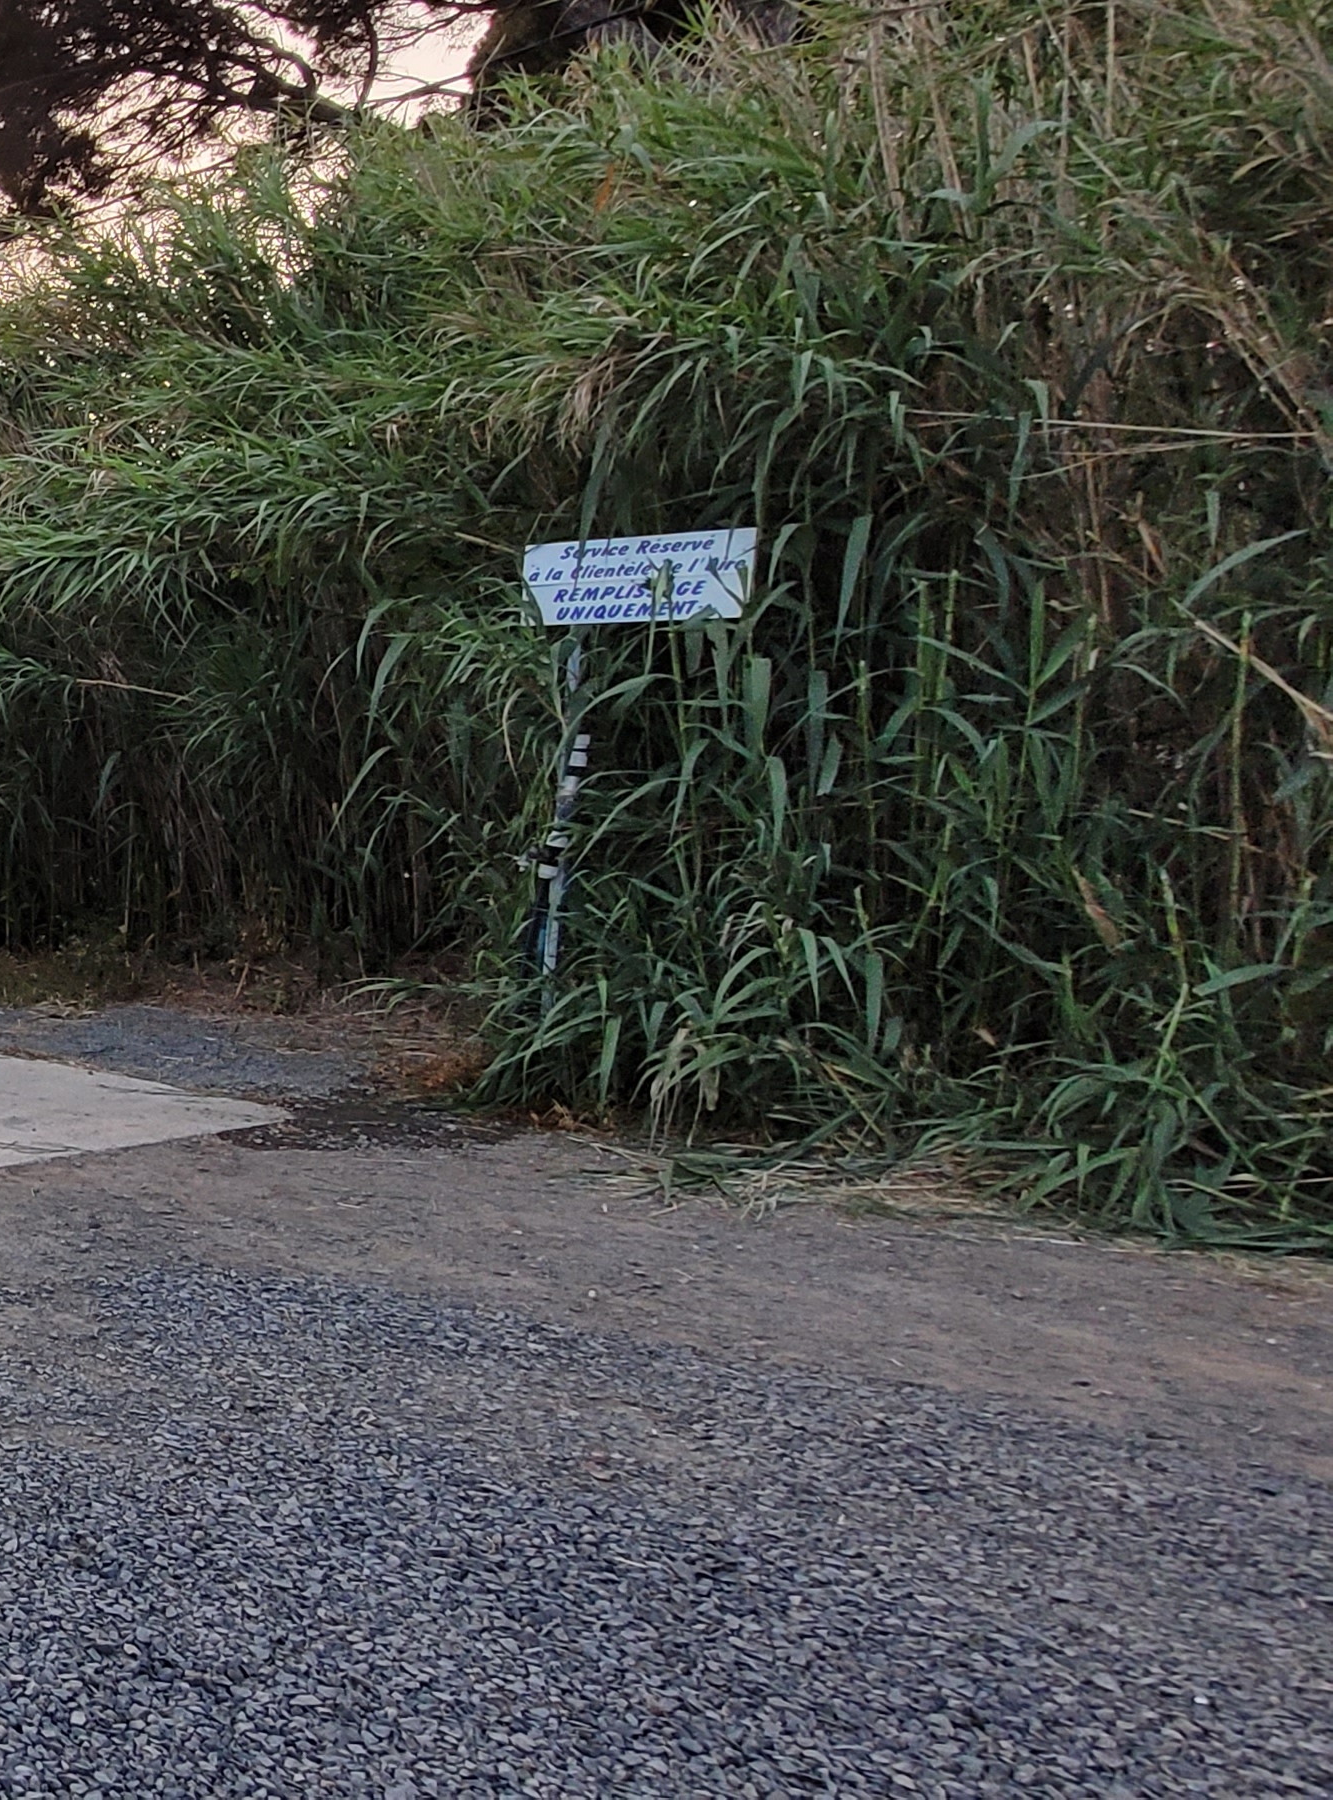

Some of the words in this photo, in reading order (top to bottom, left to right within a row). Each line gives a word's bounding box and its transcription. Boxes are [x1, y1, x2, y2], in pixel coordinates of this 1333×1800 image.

[560, 544, 630, 560] Service
[636, 534, 715, 555] Réservé
[545, 567, 564, 582] la
[553, 580, 707, 603] REMPLISGE
